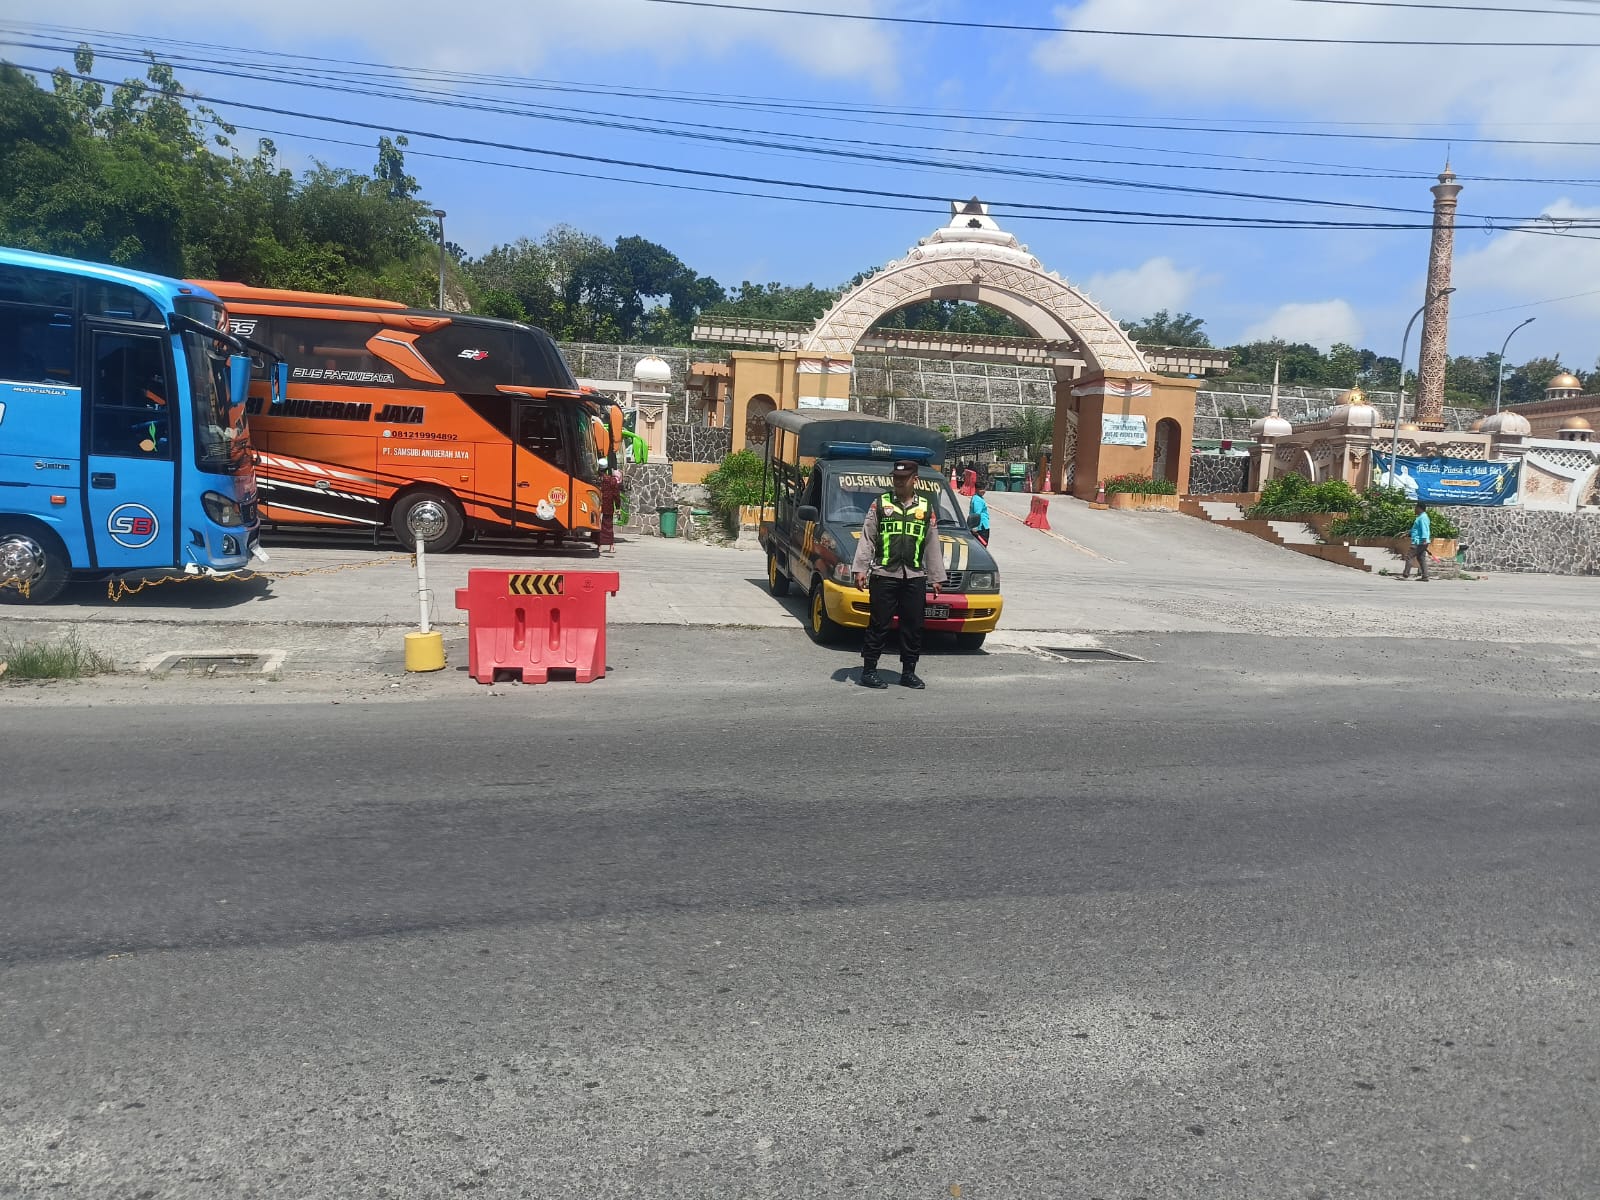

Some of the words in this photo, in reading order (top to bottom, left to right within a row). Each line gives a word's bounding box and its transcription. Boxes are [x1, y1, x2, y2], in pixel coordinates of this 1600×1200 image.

[292, 367, 323, 378] BUS
[323, 369, 395, 383] PARIWISATA
[267, 398, 373, 422] ANUGERAH
[374, 403, 424, 424] JAYA
[382, 447, 393, 456] PT.
[421, 450, 453, 459] ANUGERAH
[454, 451, 469, 460] JAYA
[839, 475, 877, 487] POLSEK
